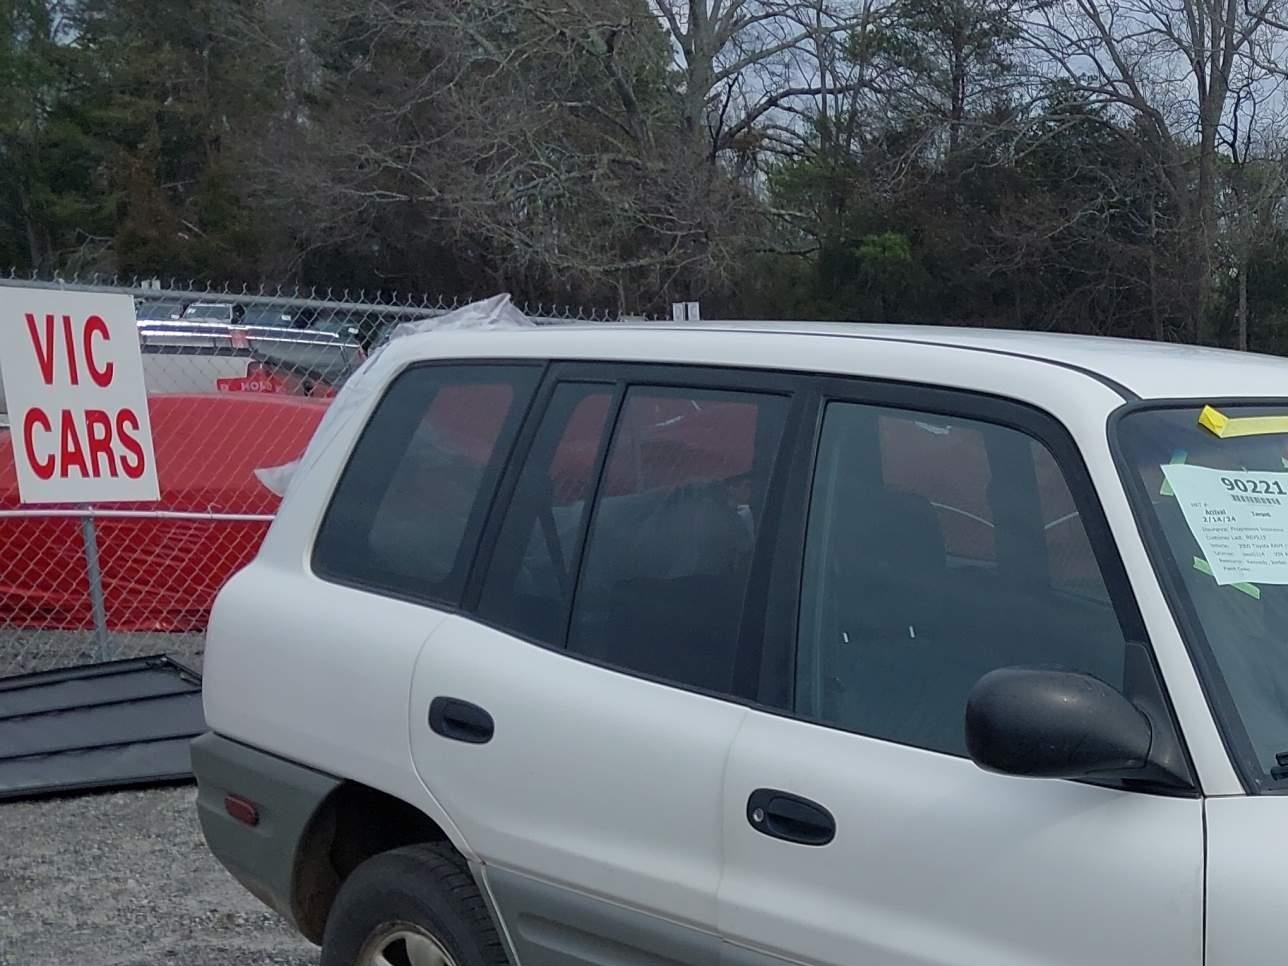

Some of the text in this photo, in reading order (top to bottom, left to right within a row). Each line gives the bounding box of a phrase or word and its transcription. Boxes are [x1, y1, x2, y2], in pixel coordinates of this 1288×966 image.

[25, 313, 114, 387] VIC
[23, 407, 145, 480] CARS
[1220, 477, 1287, 495] 90221
